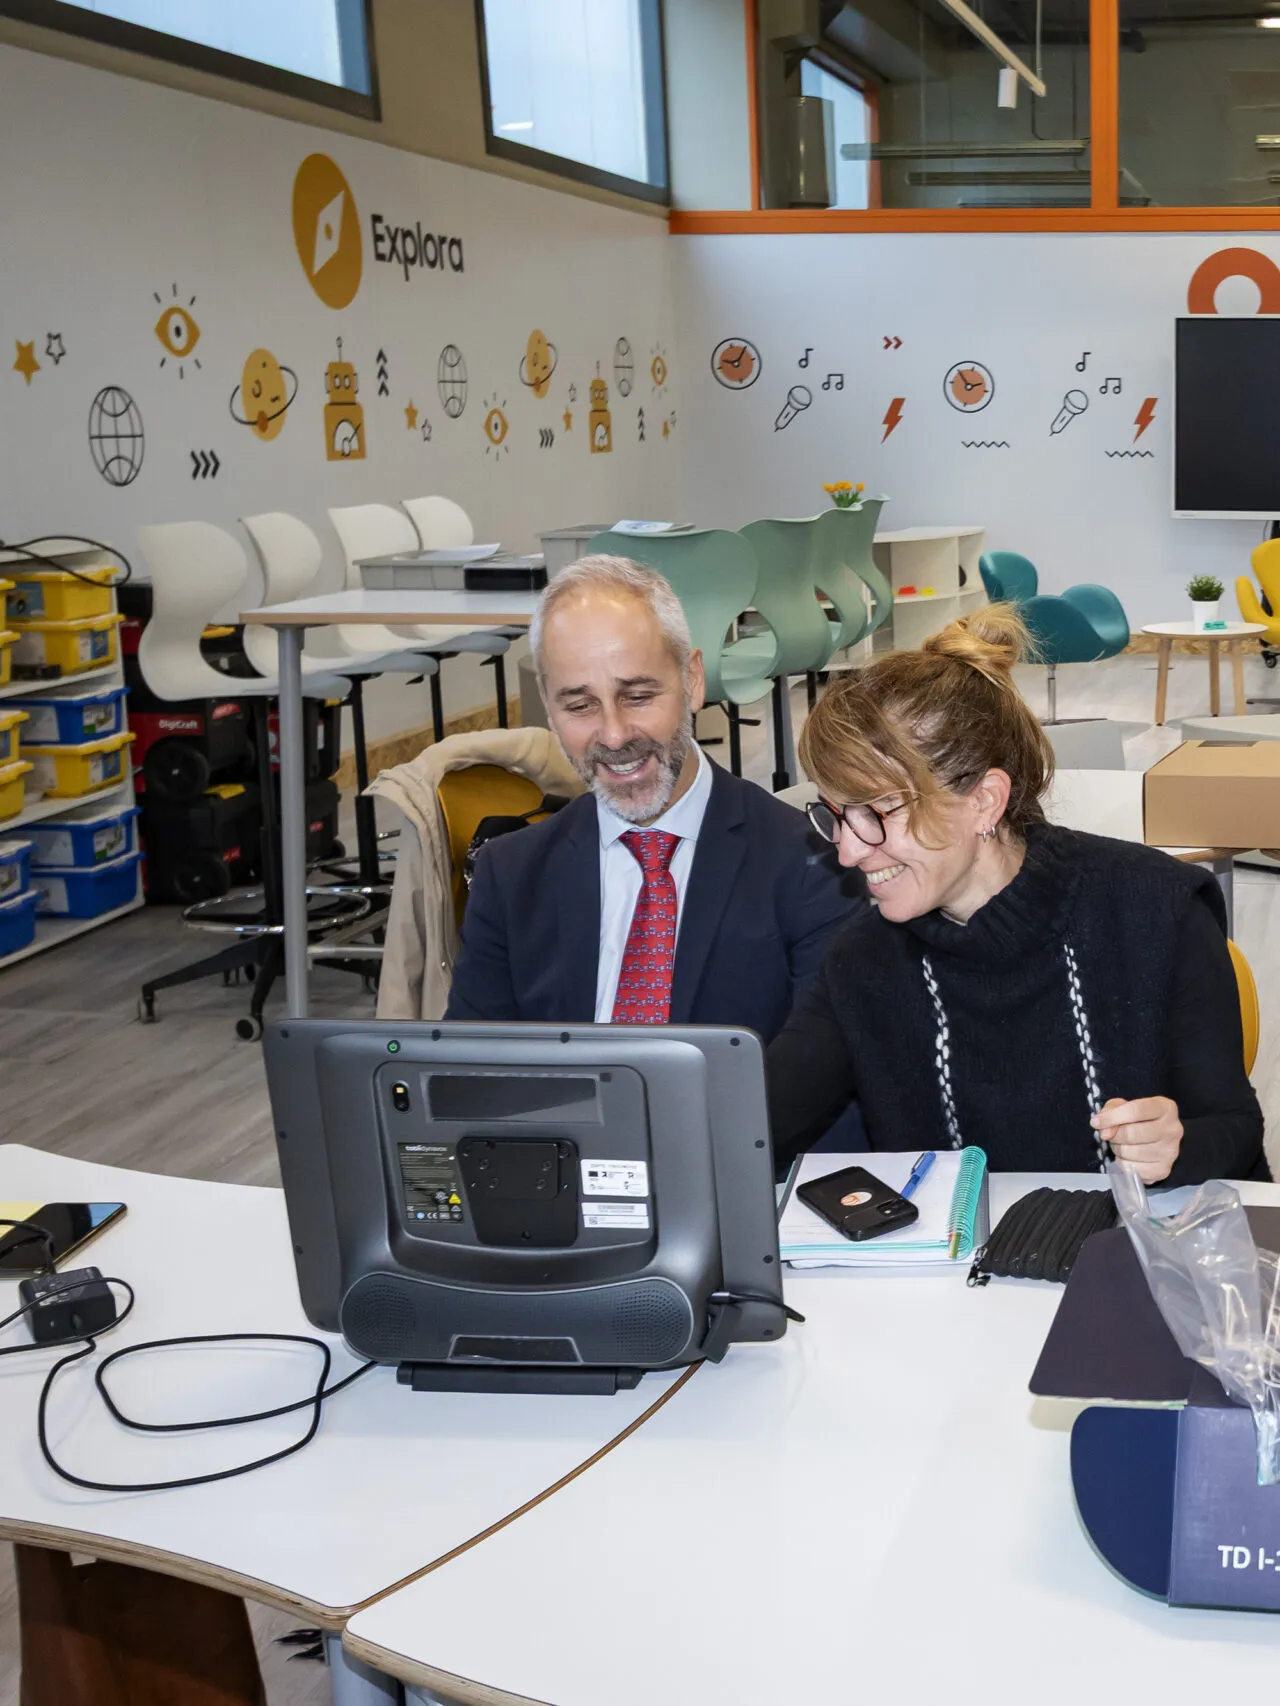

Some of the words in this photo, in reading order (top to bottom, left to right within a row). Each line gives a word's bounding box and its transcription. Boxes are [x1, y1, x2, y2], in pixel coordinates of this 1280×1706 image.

[371, 213, 464, 282] Explora
[158, 719, 198, 730] DigiCraft
[1217, 1544, 1251, 1569] TD
